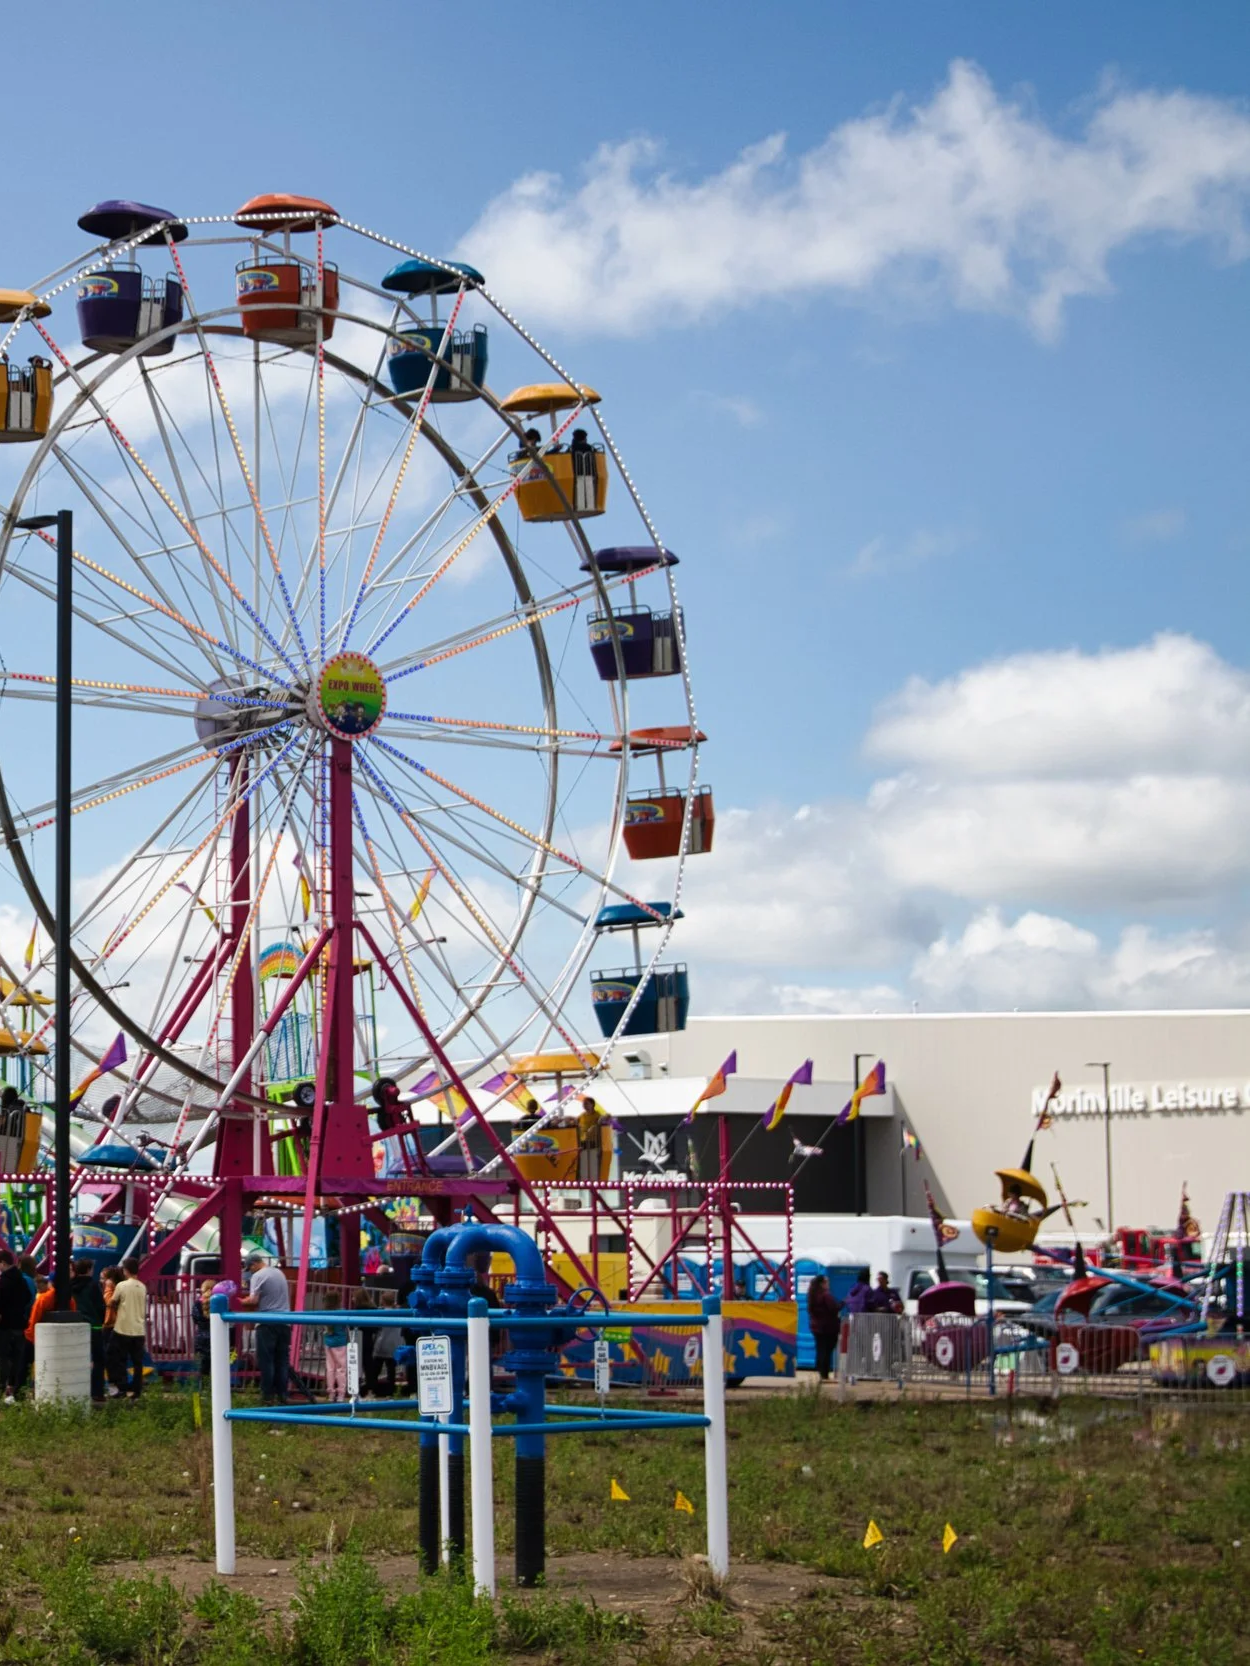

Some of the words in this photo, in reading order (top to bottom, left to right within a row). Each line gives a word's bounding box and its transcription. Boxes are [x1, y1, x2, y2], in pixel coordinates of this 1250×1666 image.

[328, 679, 349, 691] EXPO
[352, 682, 377, 694] WHEEL
[1031, 1084, 1145, 1114] Morinville
[1151, 1082, 1238, 1109] Leisure
[387, 1180, 443, 1192] ENTRANCE
